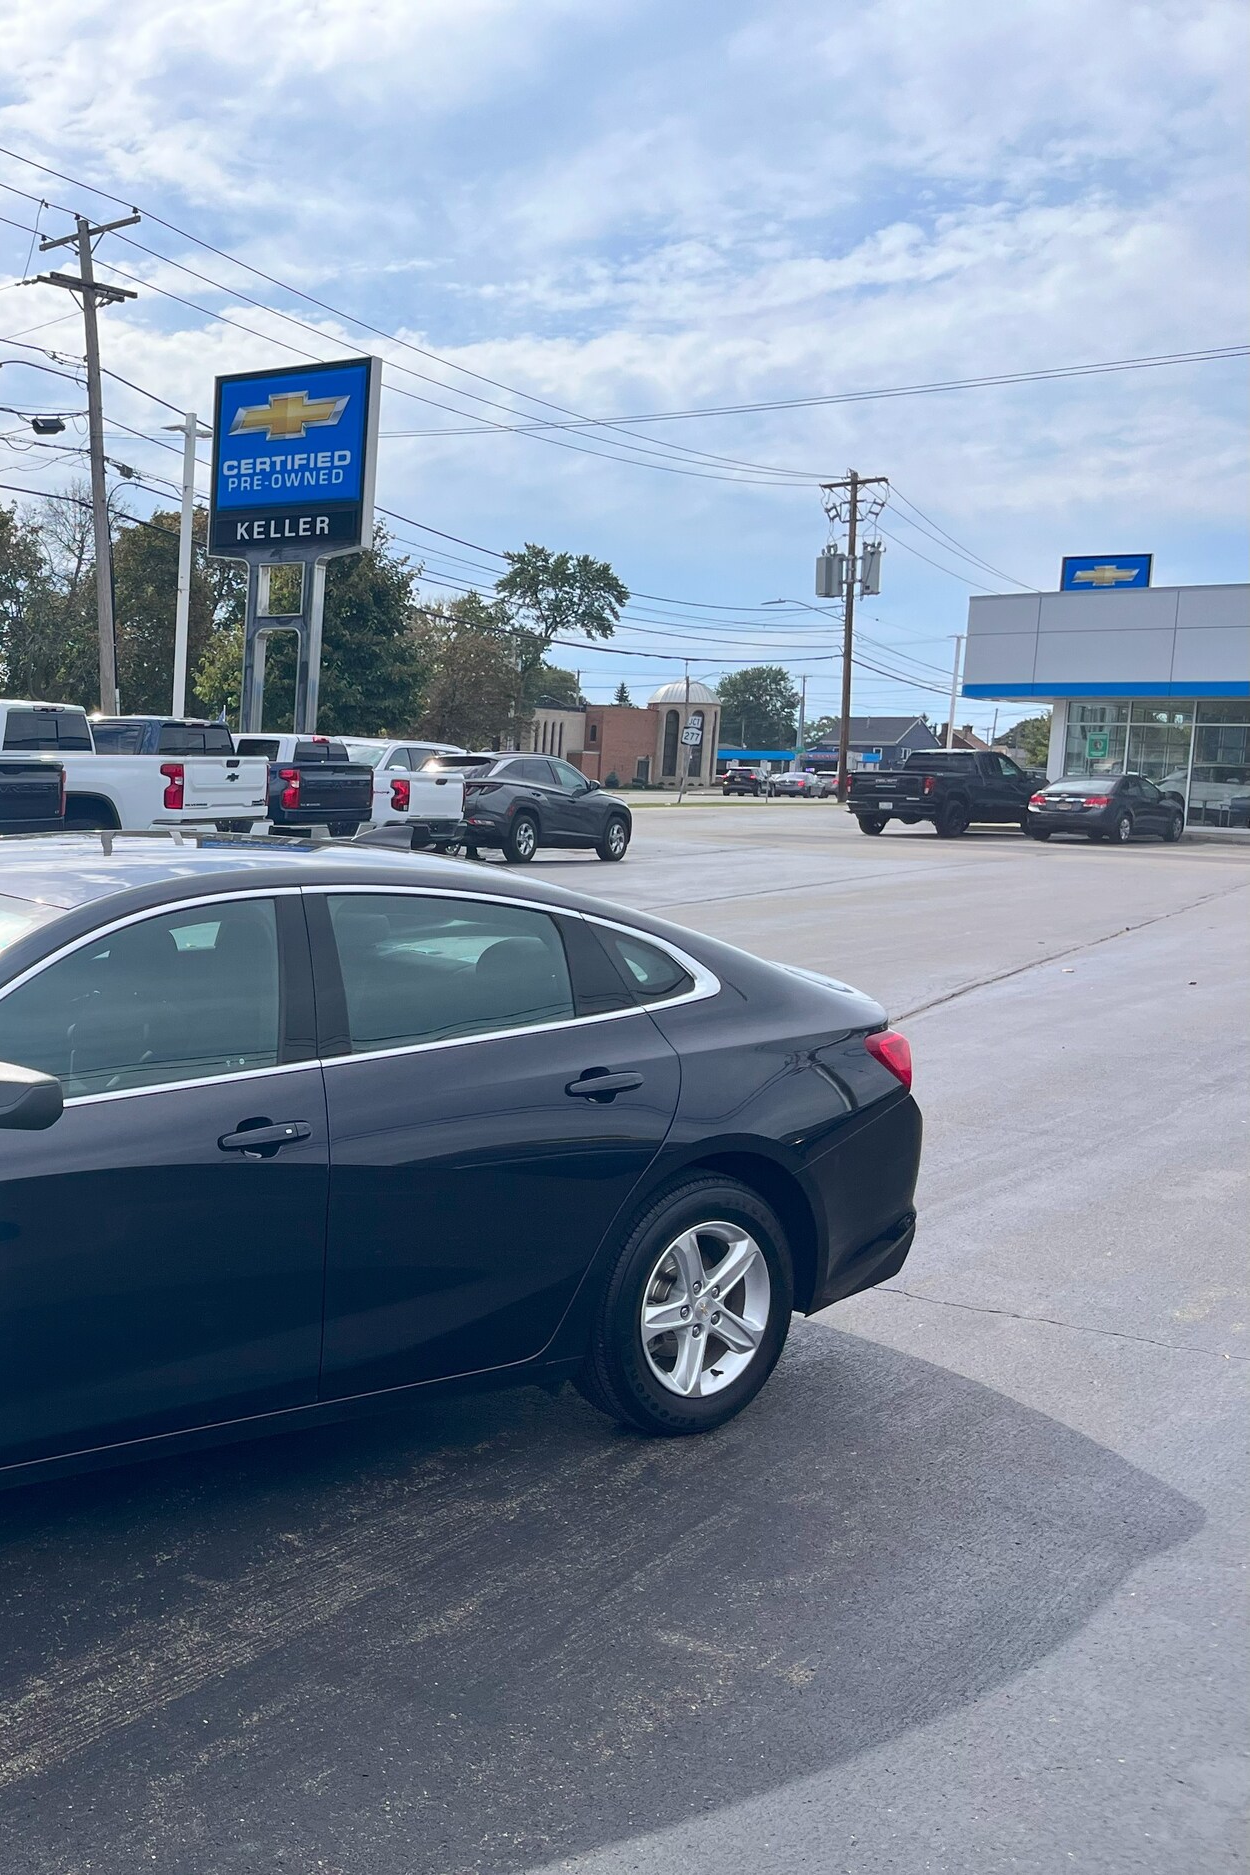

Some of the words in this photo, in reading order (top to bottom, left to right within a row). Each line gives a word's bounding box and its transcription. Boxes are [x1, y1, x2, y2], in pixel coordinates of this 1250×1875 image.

[222, 449, 352, 477] CERTIFIED
[227, 468, 344, 492] PRE-OWNED
[236, 516, 330, 541] KELLER
[688, 718, 700, 726] JCT
[683, 731, 700, 741] 277
